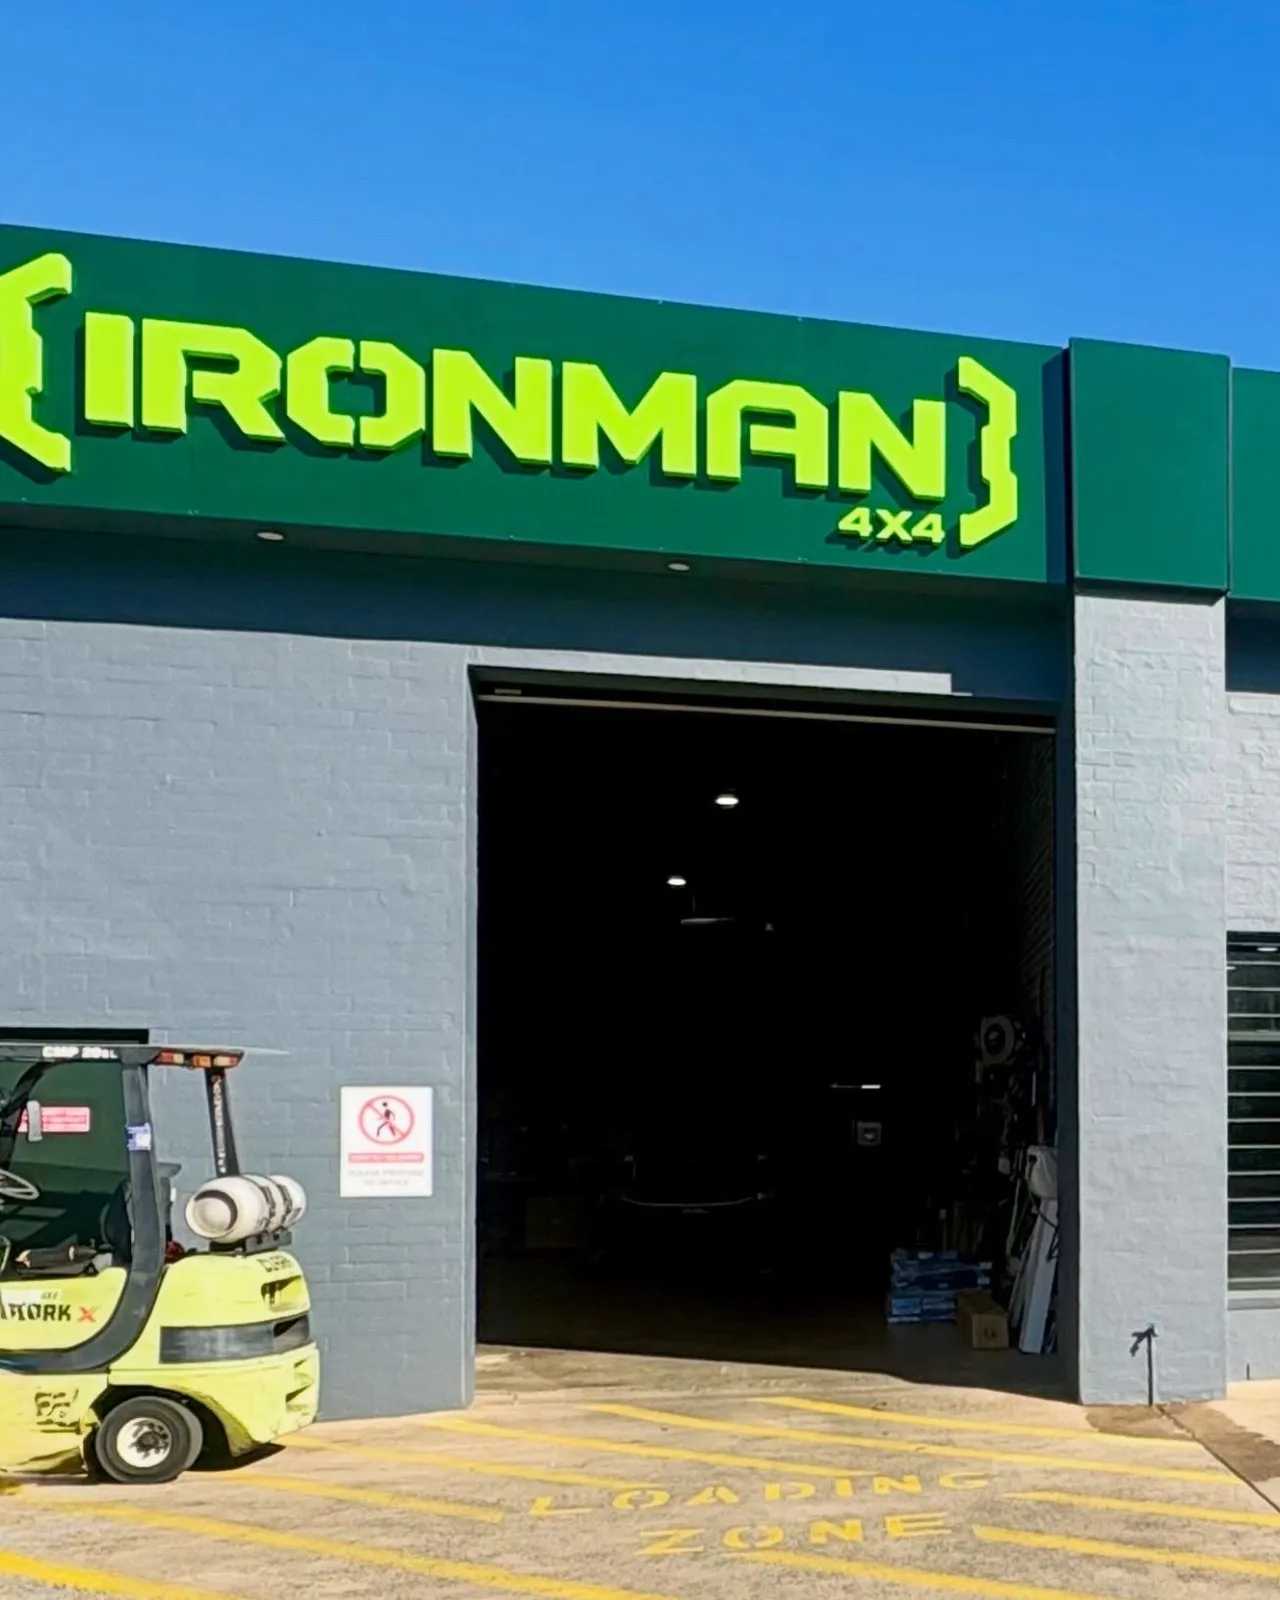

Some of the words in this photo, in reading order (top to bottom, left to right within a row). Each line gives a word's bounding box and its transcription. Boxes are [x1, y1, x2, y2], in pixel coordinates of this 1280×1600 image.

[84, 311, 946, 500] IRONMAN
[837, 506, 945, 545] 4X4
[529, 1471, 990, 1516] LOADING
[635, 1511, 953, 1556] ZONE
